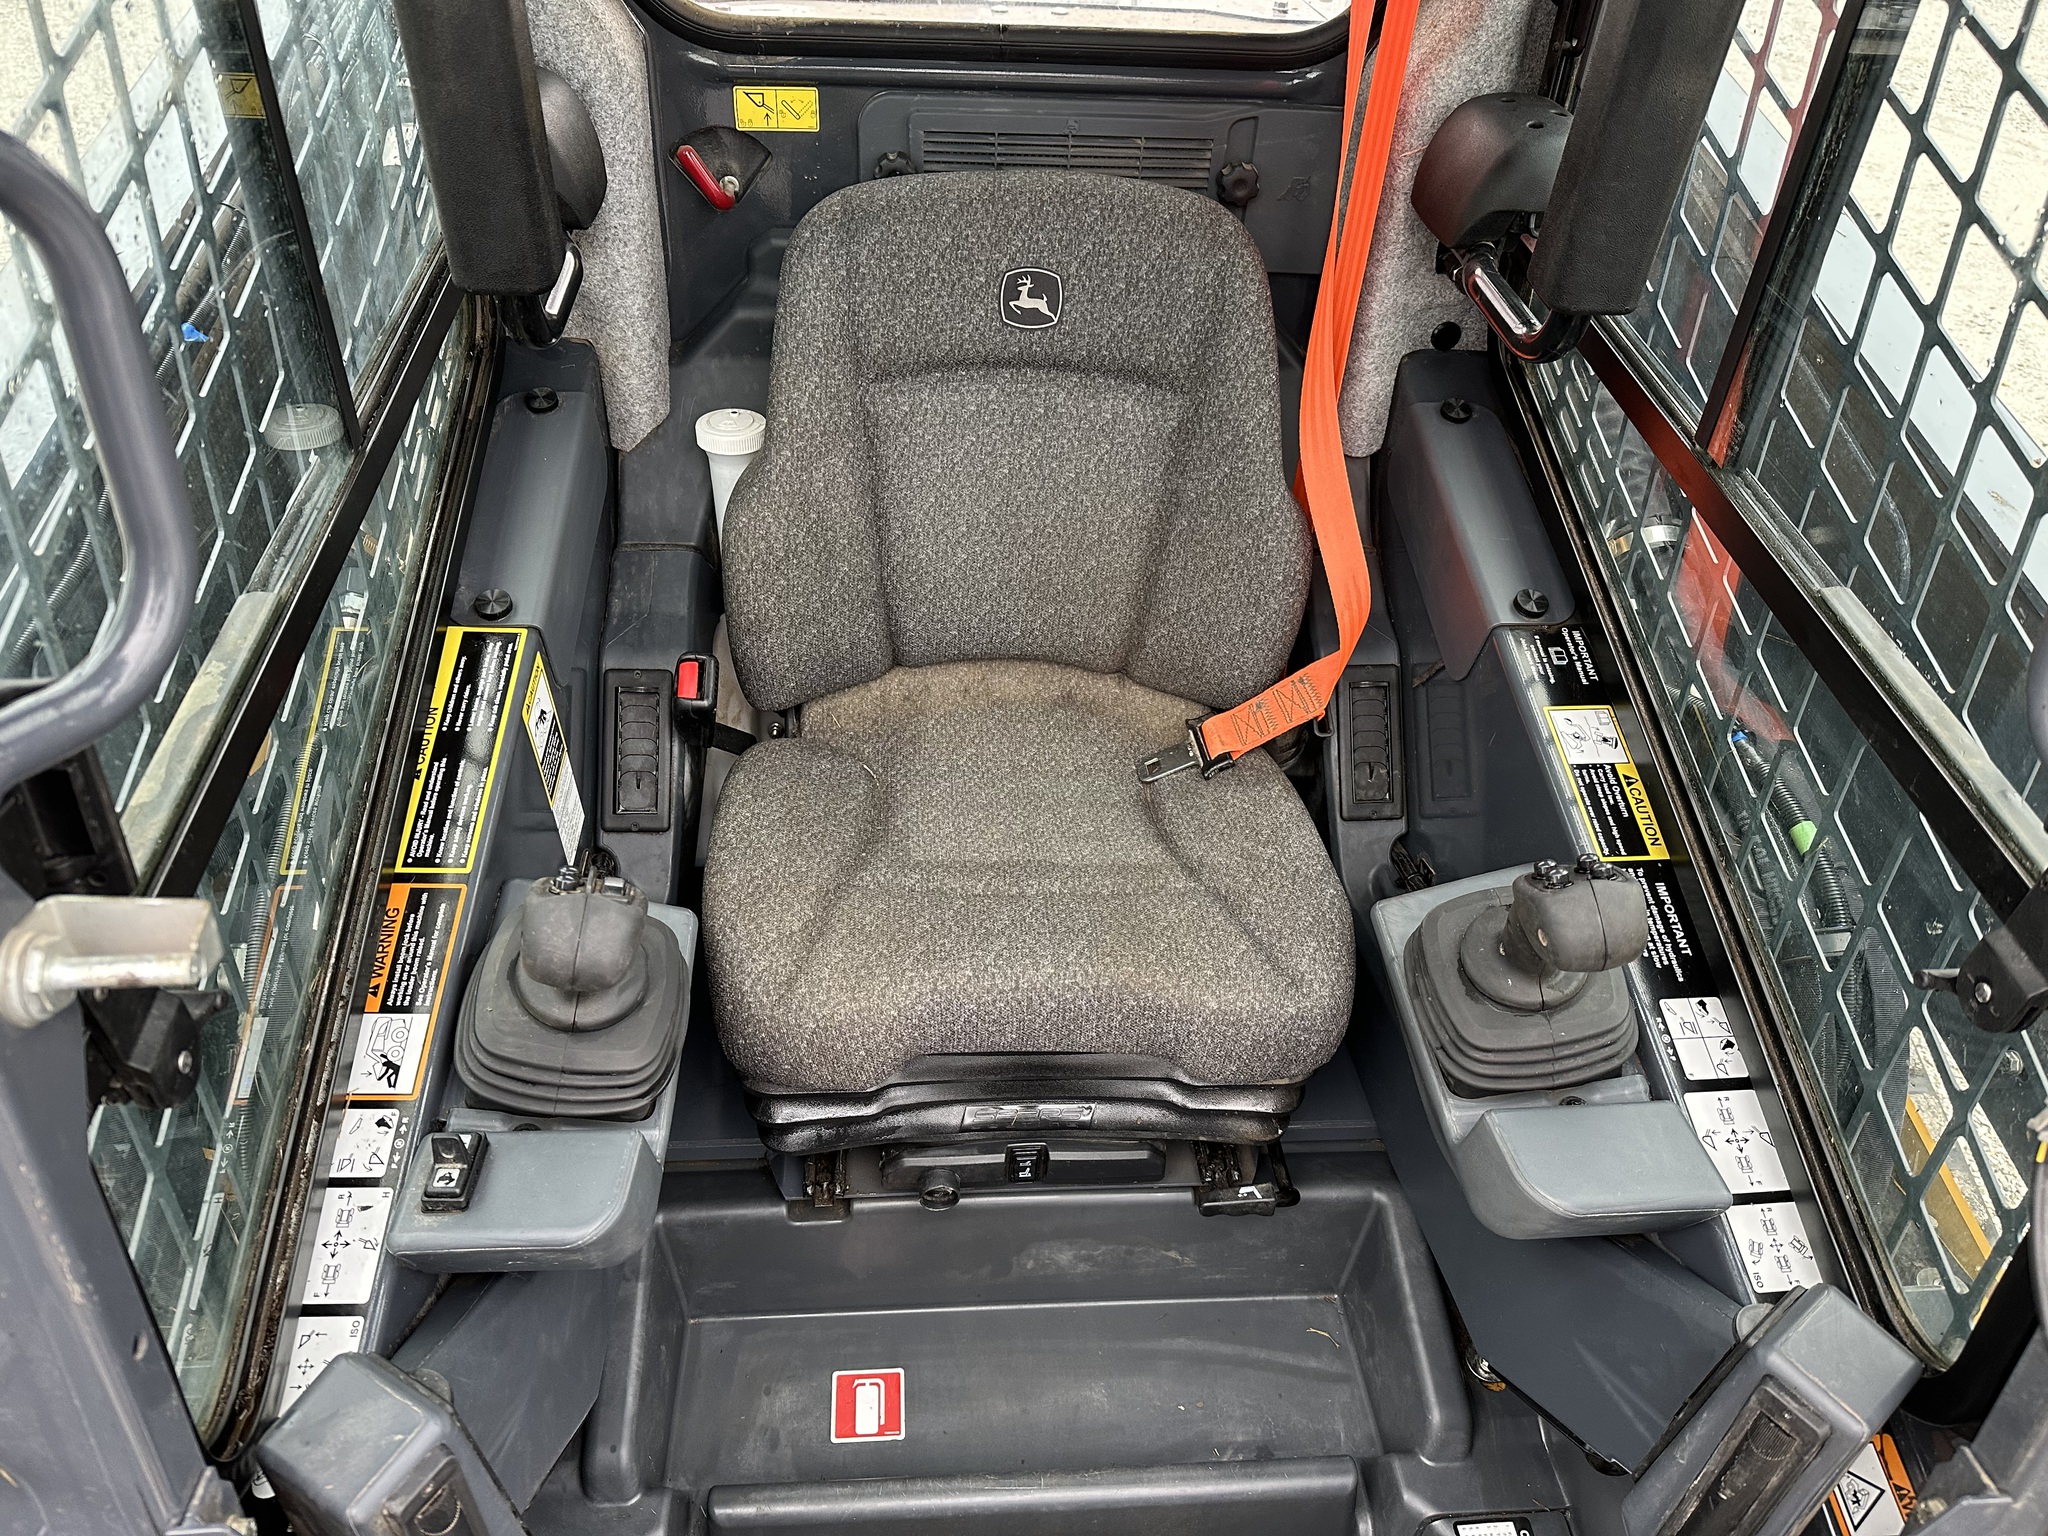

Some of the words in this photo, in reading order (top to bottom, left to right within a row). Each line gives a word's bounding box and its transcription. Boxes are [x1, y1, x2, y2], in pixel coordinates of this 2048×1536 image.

[1562, 628, 1578, 660] Operator's
[1575, 662, 1589, 684] Manual
[1572, 631, 1598, 680] IMPORTANT
[443, 714, 452, 726] Keep
[448, 694, 456, 713] children
[1598, 769, 1606, 782] Carry
[463, 784, 473, 804] working.
[474, 788, 483, 810] windows
[1604, 764, 1617, 784] Avoid
[1612, 786, 1628, 817] Overturn
[410, 840, 418, 857] AVOID
[414, 819, 424, 839] INJURY
[420, 802, 428, 815] Read
[428, 762, 439, 790] understand
[416, 830, 428, 857] Operator's
[424, 810, 433, 828] Manual
[429, 793, 438, 809] before
[435, 768, 445, 792] operating
[436, 842, 444, 857] Know
[440, 820, 450, 841] location
[448, 787, 458, 808] function
[456, 759, 466, 780] controls.
[457, 806, 466, 826] devices
[1589, 769, 1599, 783] Avoid
[1595, 784, 1604, 797] steep
[1601, 798, 1610, 815] slopes
[1608, 816, 1616, 825] and
[1612, 827, 1620, 838] high
[1616, 839, 1627, 855] speed
[1629, 787, 1662, 846] CAUTION
[1580, 787, 1590, 805] operate
[1592, 819, 1602, 832] rated
[1598, 833, 1609, 855] capacity.
[453, 827, 462, 842] safety
[464, 822, 475, 843] screens
[425, 834, 434, 857] machine.
[449, 844, 458, 857] Keep
[461, 844, 470, 857] Keep
[1636, 868, 1644, 876] To
[1638, 878, 1655, 904] prevent
[405, 914, 415, 932] before
[435, 903, 446, 929] complete
[1650, 905, 1665, 933] damage
[1655, 883, 1692, 956] IMPORTANT
[371, 908, 399, 978] WARNING
[402, 934, 410, 946] lock
[416, 937, 425, 956] raised.
[426, 940, 437, 960] Manual
[1646, 917, 1669, 965] temperatures
[396, 982, 407, 1006] working
[405, 943, 416, 963] around
[415, 906, 425, 929] machine
[397, 946, 407, 963] boom
[1651, 951, 1662, 968] slow
[1664, 944, 1683, 982] hydraulics
[392, 965, 402, 982] install
[410, 958, 420, 974] boom
[406, 976, 415, 994] loader
[419, 962, 432, 993] Operator's
[423, 969, 438, 1006] instructions.
[387, 984, 397, 1006] Always
[416, 994, 424, 1006] See
[1752, 1272, 1764, 1289] ISO
[350, 1320, 360, 1338] ISO
